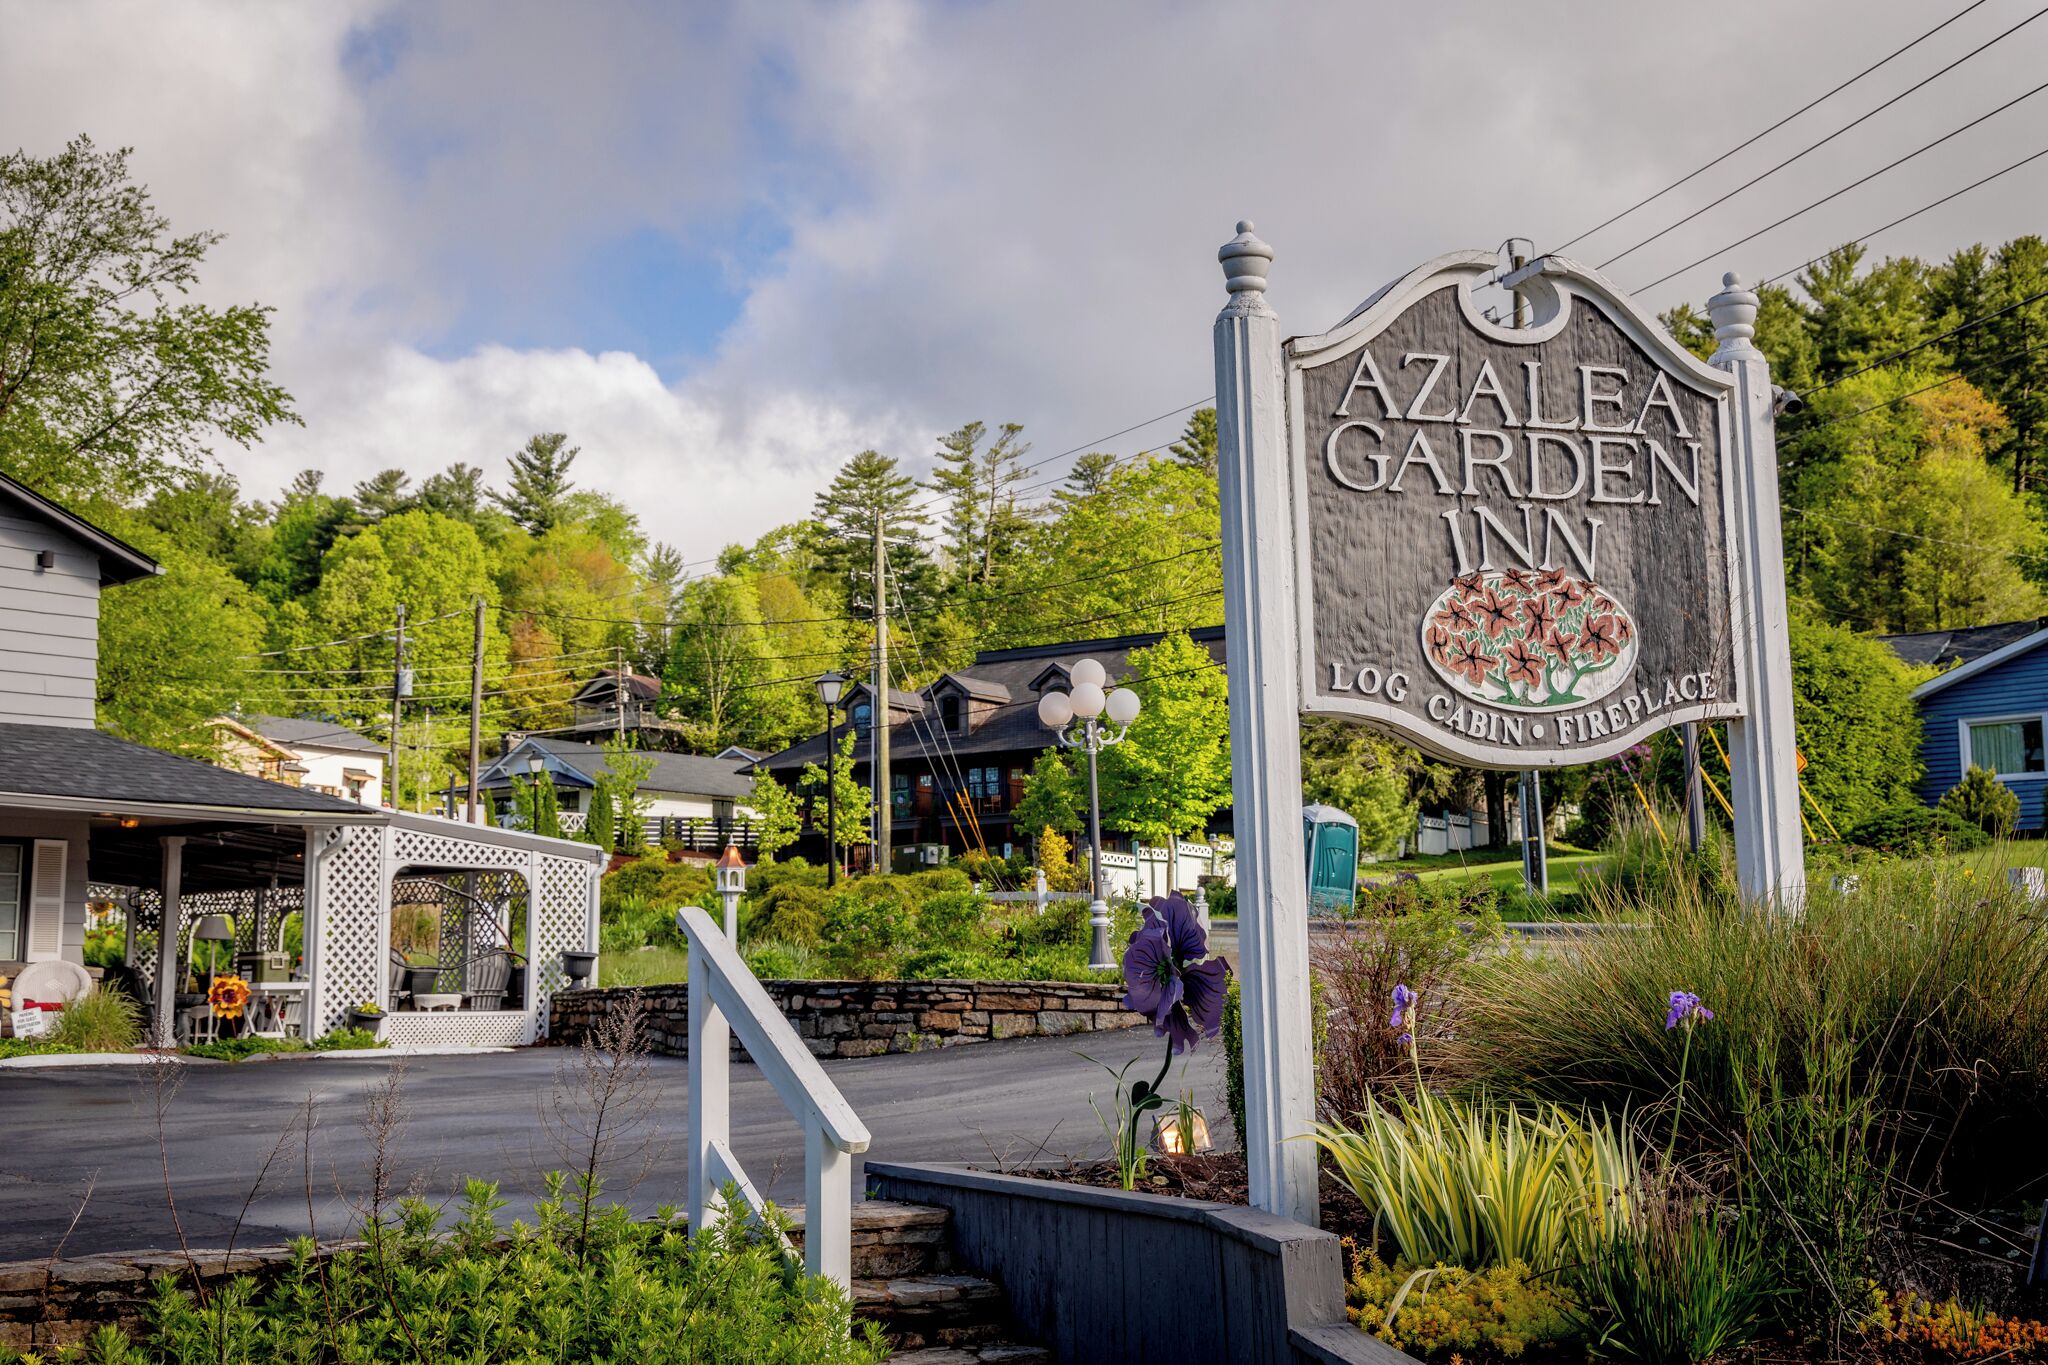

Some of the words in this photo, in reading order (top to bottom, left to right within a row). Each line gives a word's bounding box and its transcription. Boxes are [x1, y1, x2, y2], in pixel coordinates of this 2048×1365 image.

[1336, 349, 1693, 438] AZALEA
[1327, 420, 1702, 506] GARDEN
[1442, 504, 1603, 581] INN
[1331, 662, 1409, 701] LOG
[1428, 694, 1524, 745] CABIN
[1556, 672, 1717, 745] FIREPLACE
